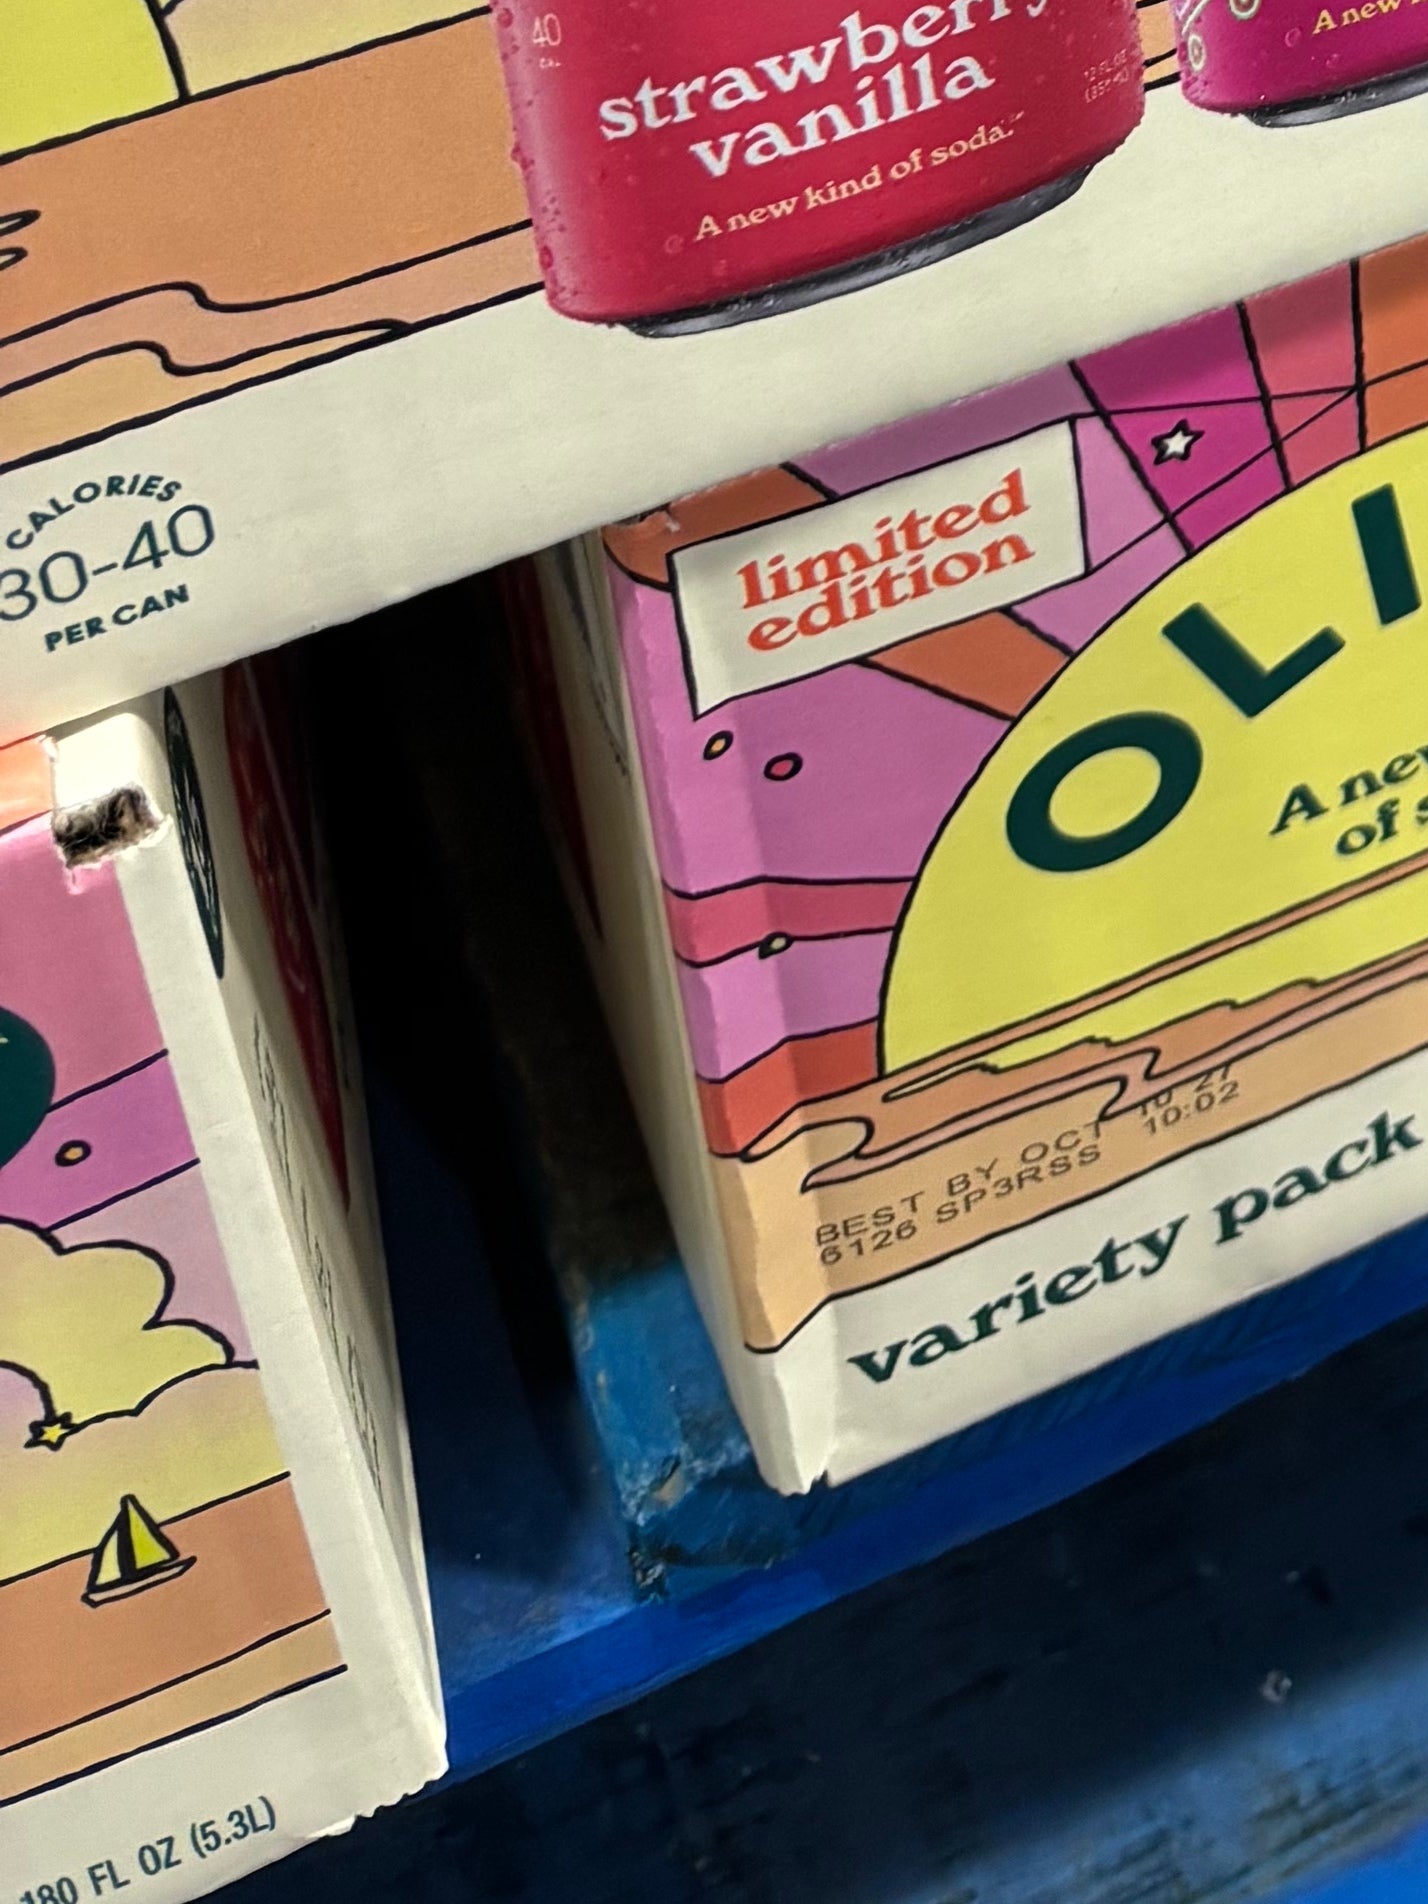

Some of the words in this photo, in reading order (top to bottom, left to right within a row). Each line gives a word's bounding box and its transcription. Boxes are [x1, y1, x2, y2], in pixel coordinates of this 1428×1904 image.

[689, 52, 996, 177] vanilla
[0, 504, 215, 621] 30-40
[6, 474, 181, 549] CALORIES
[736, 468, 1030, 609] limited
[44, 616, 107, 653] PER
[112, 584, 190, 625] CAN
[748, 534, 1035, 651] edition
[815, 1192, 926, 1246] BEST
[948, 1152, 998, 1193] BY
[1021, 1118, 1104, 1162] OCT
[820, 1220, 917, 1265] 6126
[936, 1145, 1101, 1223] SP3RSS
[1143, 1080, 1240, 1135] 10:02
[849, 1214, 1189, 1383] variety
[1214, 1110, 1425, 1244] pack
[87, 1859, 131, 1896] FL
[138, 1836, 182, 1876] OZ
[190, 1795, 276, 1859] (5.3L)
